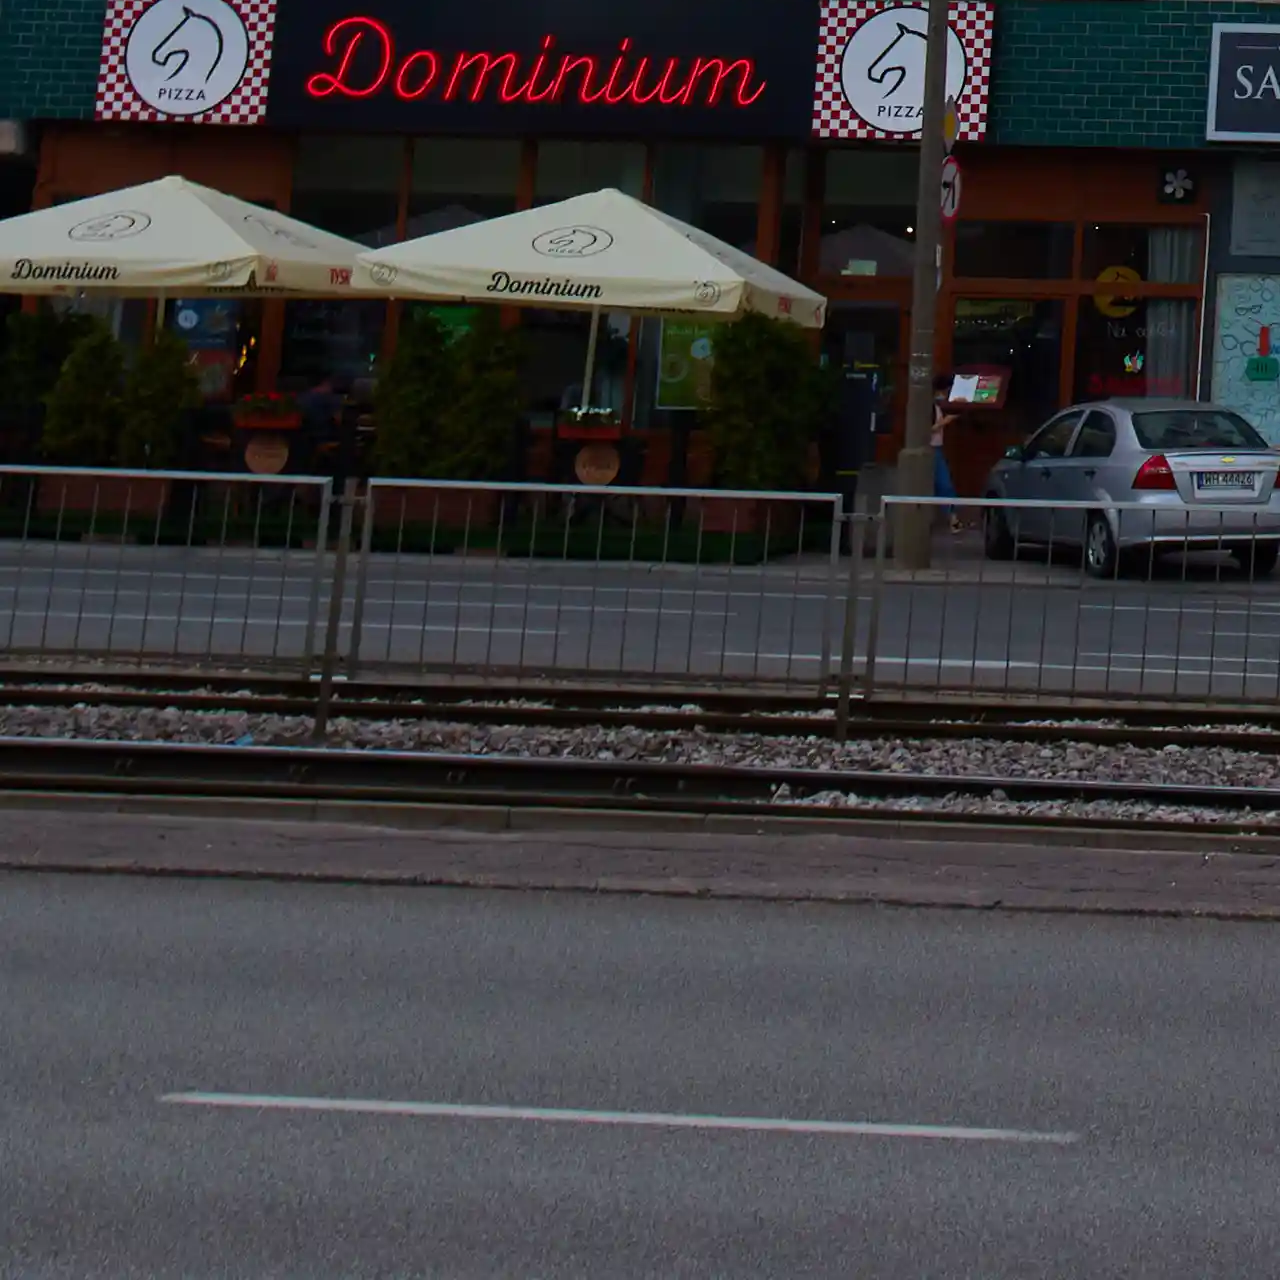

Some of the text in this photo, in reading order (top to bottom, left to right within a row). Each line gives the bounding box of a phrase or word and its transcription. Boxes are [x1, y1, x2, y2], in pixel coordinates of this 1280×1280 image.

[304, 14, 767, 108] Dominium
[158, 88, 206, 101] PIZZA
[877, 105, 924, 119] PIZZA
[11, 258, 120, 280] Dominium
[487, 271, 604, 299] Dominium
[1205, 472, 1220, 484] WH
